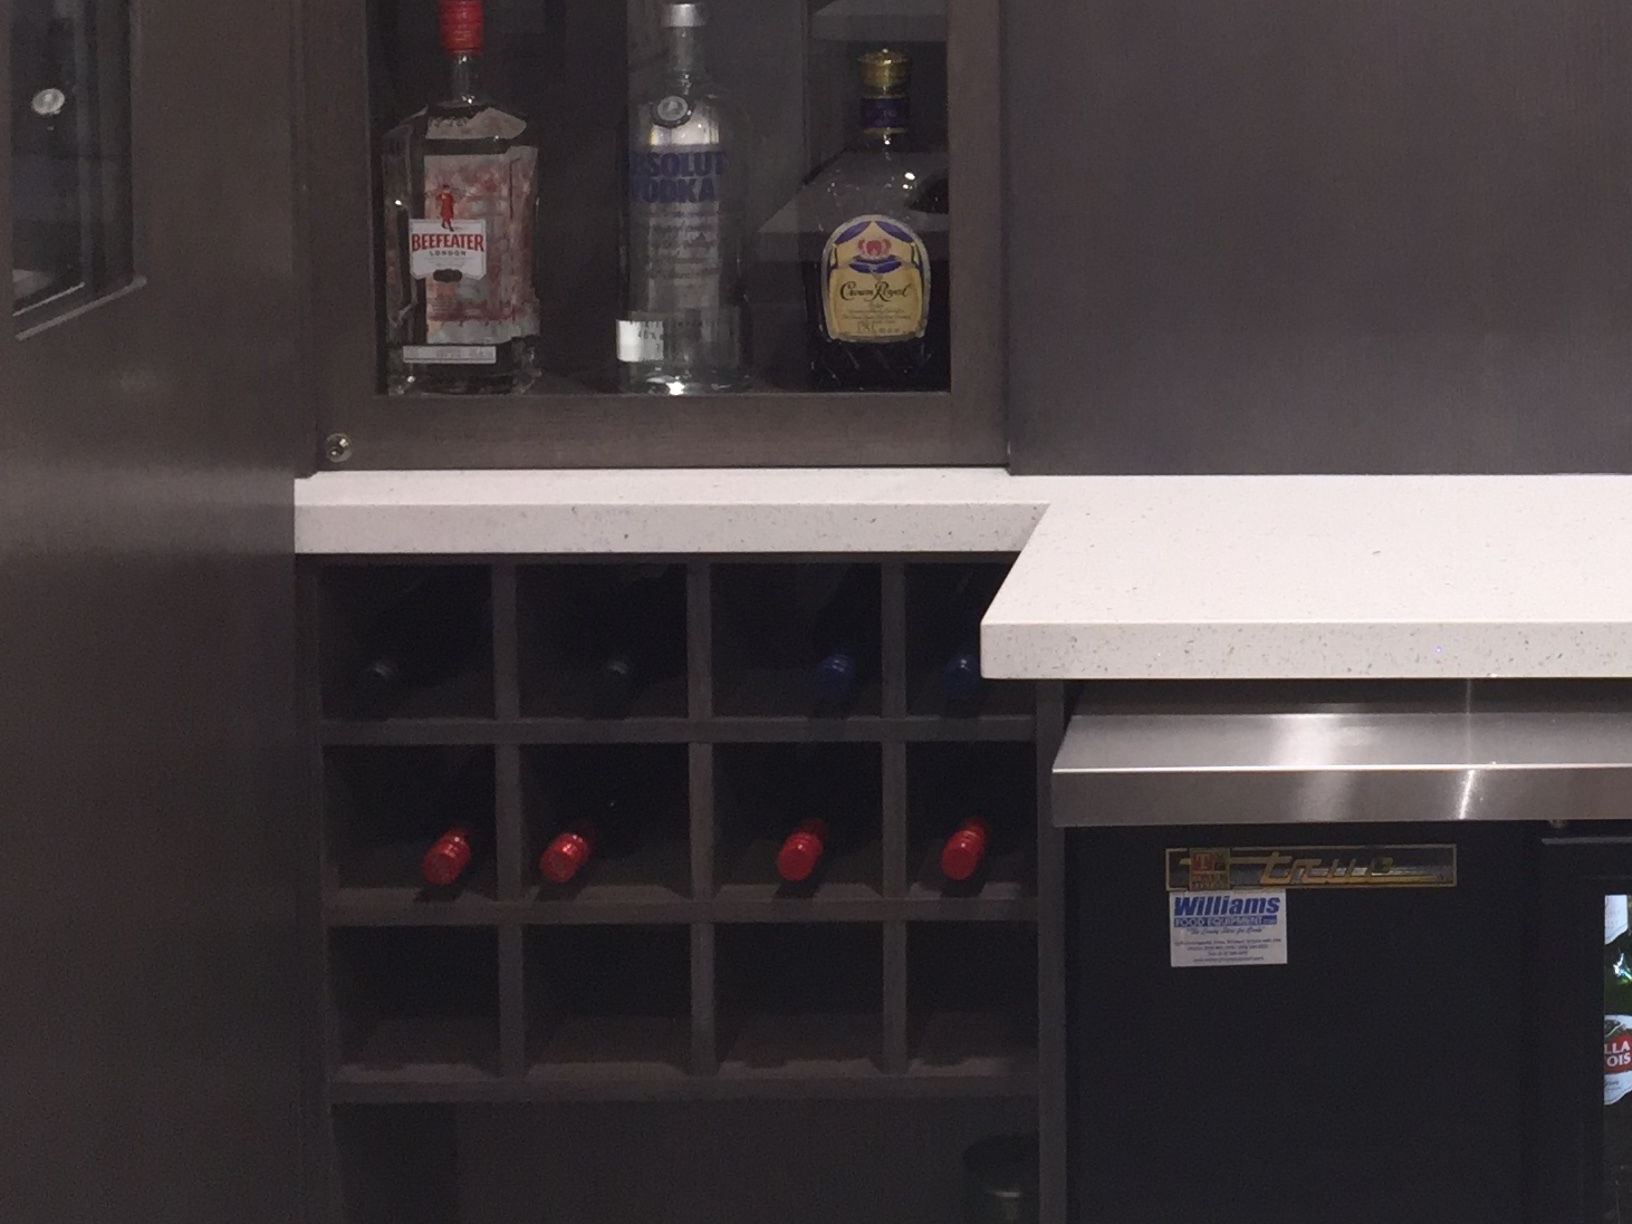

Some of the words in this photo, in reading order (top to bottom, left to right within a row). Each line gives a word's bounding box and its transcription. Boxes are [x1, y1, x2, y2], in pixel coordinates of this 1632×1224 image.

[411, 233, 485, 253] BEEFEATER
[1174, 895, 1281, 917] Williams
[1175, 916, 1208, 927] FOOD
